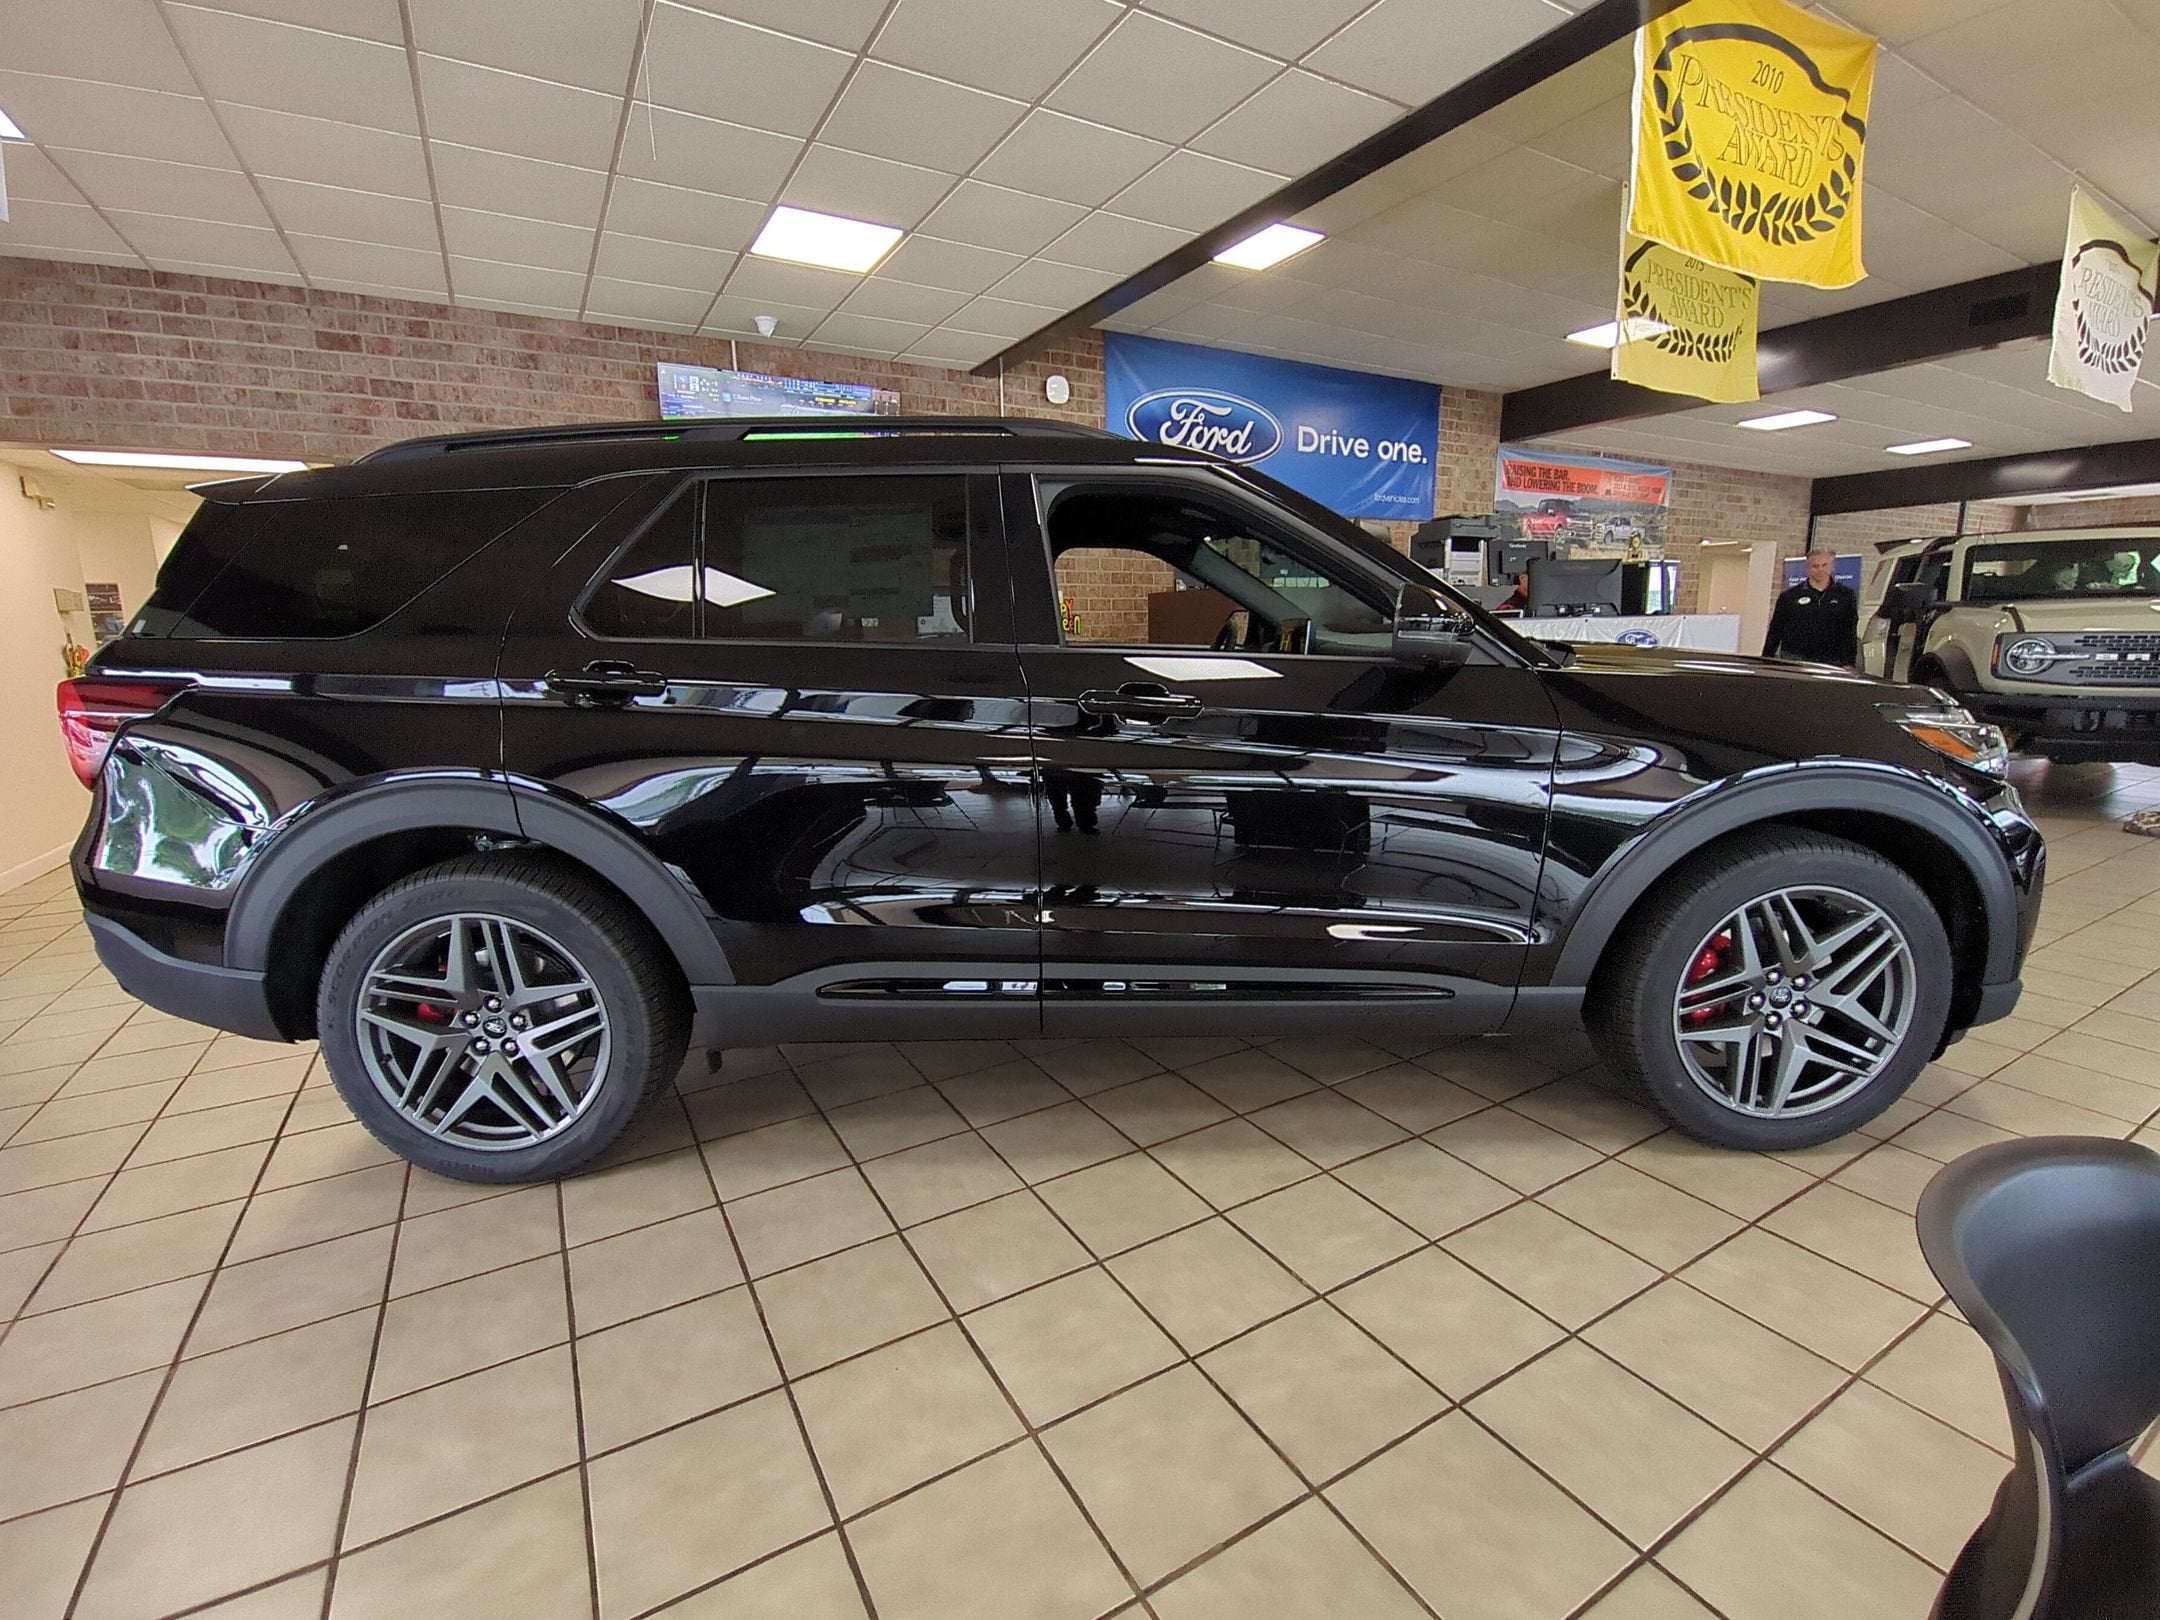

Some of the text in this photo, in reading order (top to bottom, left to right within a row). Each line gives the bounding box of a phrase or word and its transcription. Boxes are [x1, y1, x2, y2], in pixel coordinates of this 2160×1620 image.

[1751, 60, 1784, 94] 2010
[1716, 126, 1813, 188] AWARD
[1644, 259, 1752, 310] PRESIDENT'S
[1668, 295, 1725, 329] AWARD
[1160, 399, 1254, 455] Ford
[1297, 425, 1428, 464] Drive one.
[1523, 478, 1560, 491] LOWERING
[1562, 481, 1576, 493] THE
[1538, 467, 1552, 479] THE
